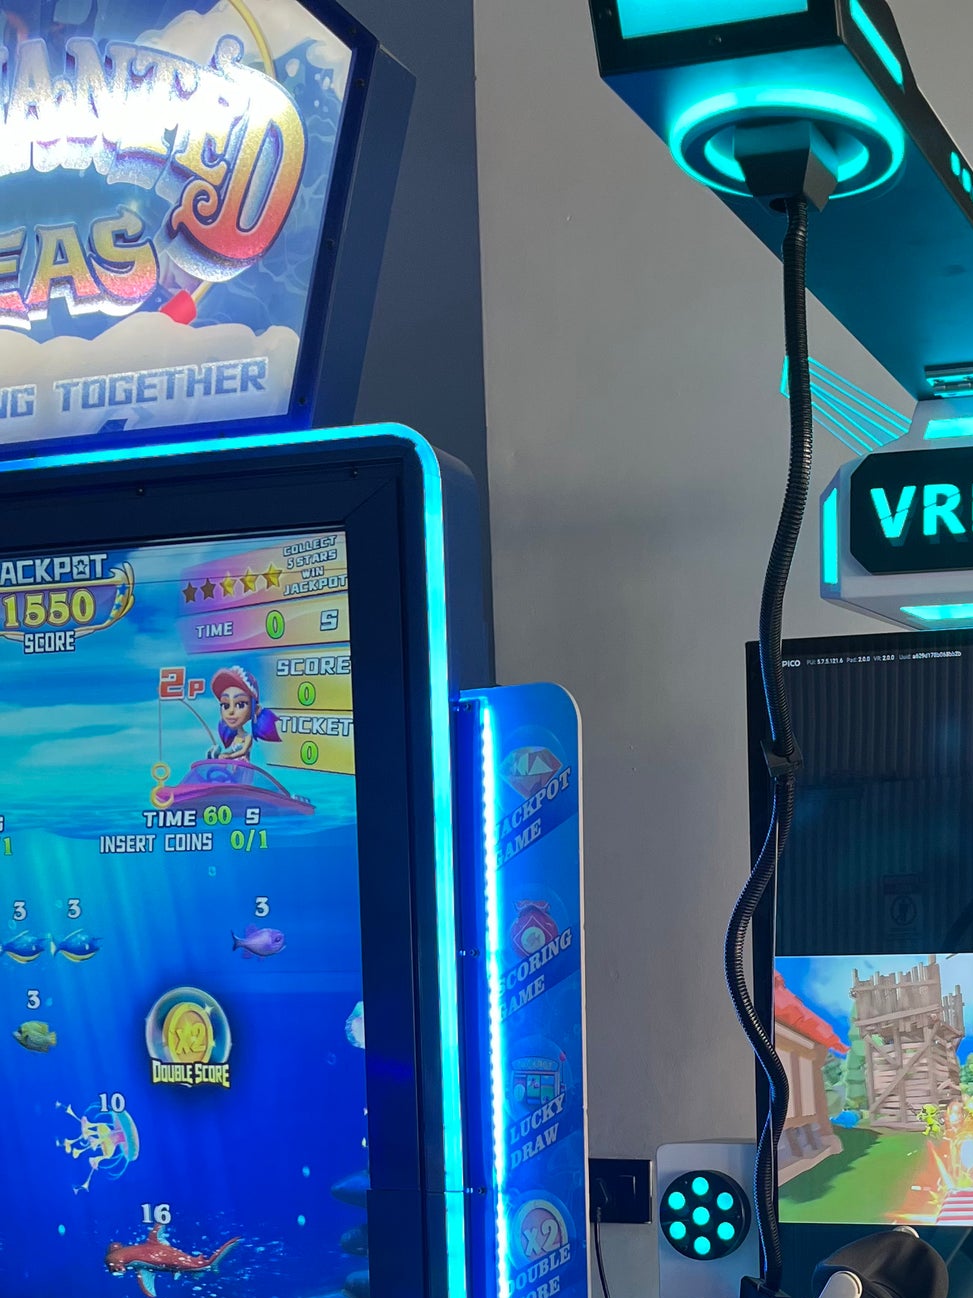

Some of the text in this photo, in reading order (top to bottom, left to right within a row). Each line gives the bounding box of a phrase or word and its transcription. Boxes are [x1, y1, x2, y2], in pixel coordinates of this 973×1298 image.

[54, 357, 268, 412] TOGETHER
[283, 535, 337, 557] COLLECT
[287, 549, 337, 569] 5 STARS
[301, 566, 324, 579] WIN
[283, 575, 348, 596] JACKPOT
[3, 587, 95, 628] 1550
[195, 622, 233, 638] TIME
[24, 631, 75, 653] SCORE
[276, 656, 351, 676] SCORE
[782, 660, 801, 668] PICO
[279, 717, 353, 736] TICKET
[143, 810, 197, 828] TIME
[203, 806, 232, 825] 60
[100, 830, 269, 854] INSERT COINS 0/1
[13, 901, 27, 921] 3
[68, 899, 81, 919] 3
[255, 897, 270, 917] 3
[26, 990, 41, 1009] 3
[100, 1093, 126, 1113] 10
[509, 1094, 565, 1146] LUCKY
[510, 1123, 560, 1170] DRAW
[141, 1204, 172, 1225] 16
